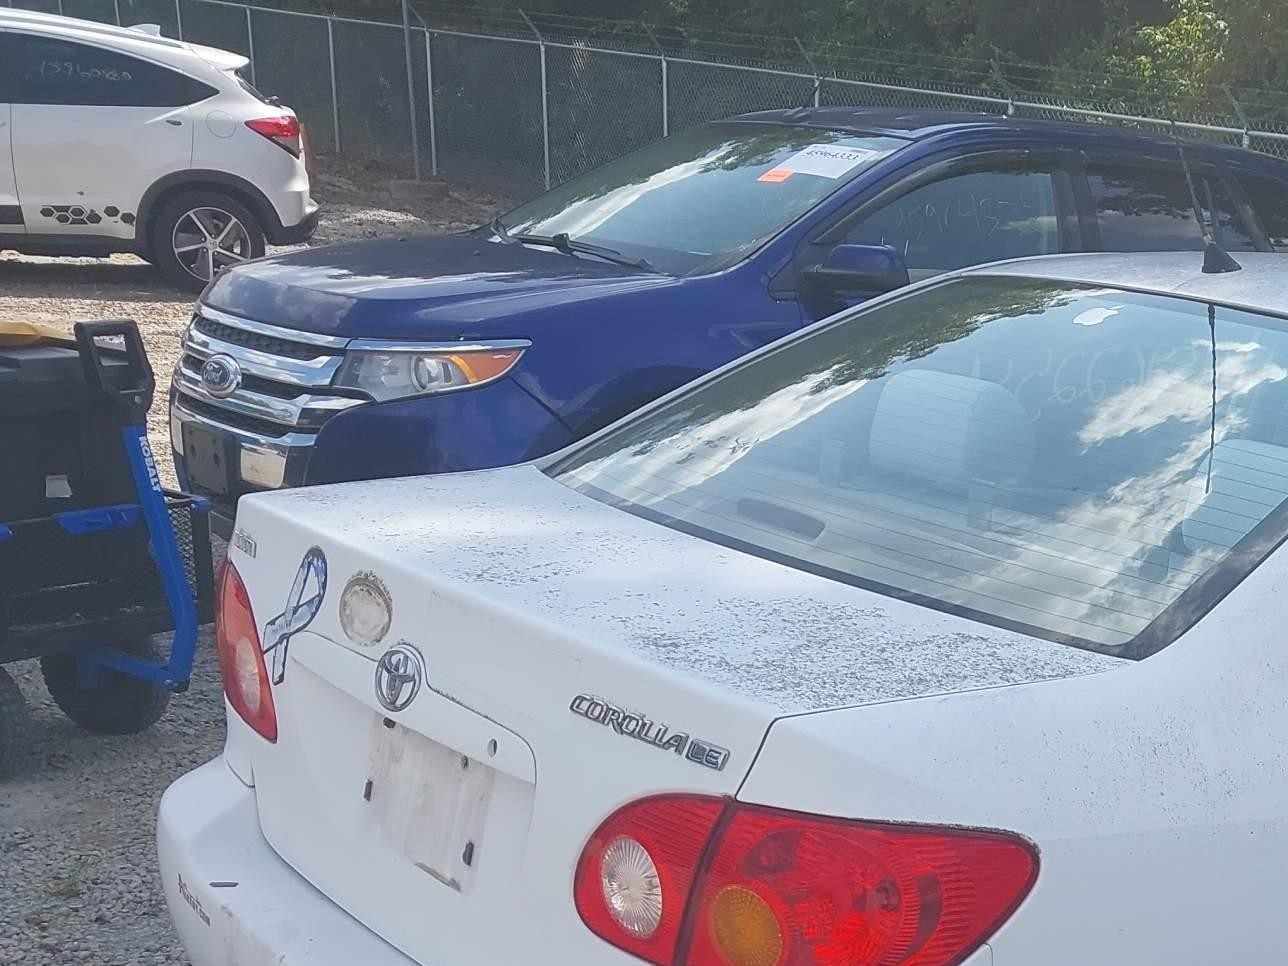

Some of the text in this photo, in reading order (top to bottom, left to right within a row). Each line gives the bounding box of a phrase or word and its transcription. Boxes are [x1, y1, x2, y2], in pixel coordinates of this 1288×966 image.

[139, 436, 161, 492] KOBALT
[570, 694, 730, 771] COROLLA LE
